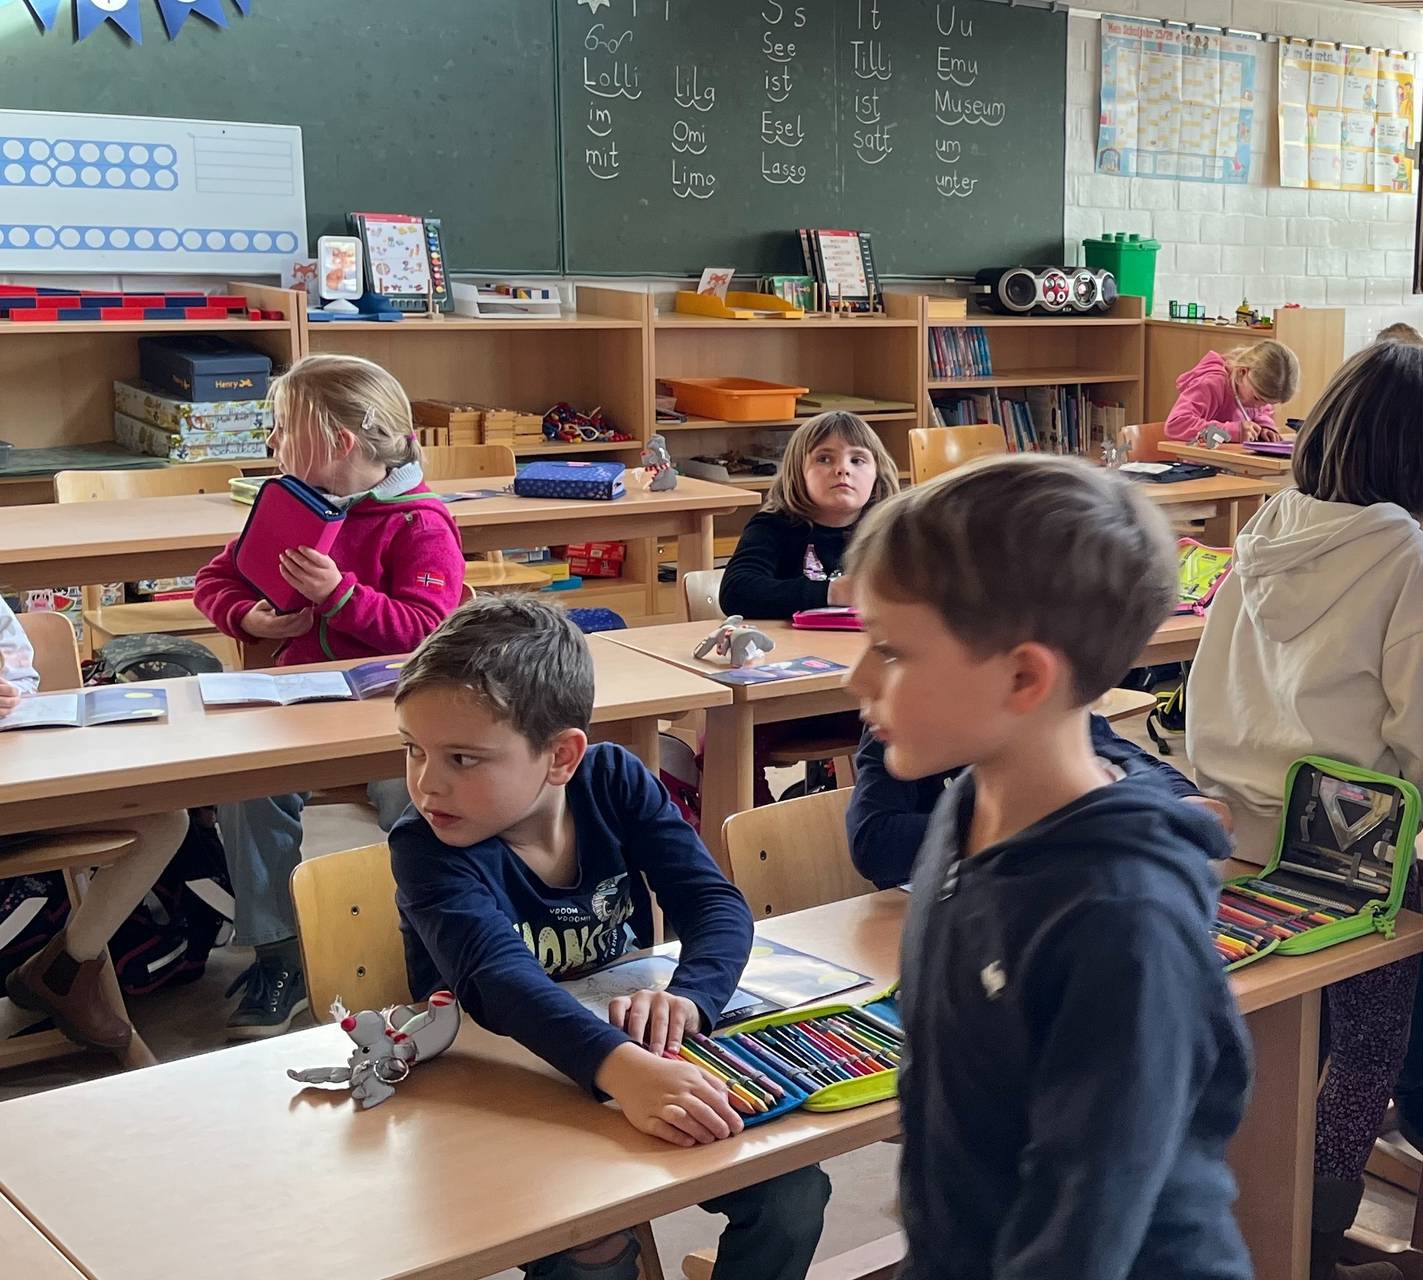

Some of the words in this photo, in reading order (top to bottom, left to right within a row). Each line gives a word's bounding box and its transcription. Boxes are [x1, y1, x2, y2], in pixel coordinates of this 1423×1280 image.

[762, 31, 796, 57] See
[850, 40, 891, 72] Tilli
[584, 57, 638, 88] Lolli
[938, 46, 979, 76] Emu
[765, 65, 793, 92] ist
[590, 101, 611, 125] im
[855, 87, 880, 118] ist
[935, 89, 1006, 117] Museum
[673, 120, 705, 143] Omi
[762, 111, 804, 138] Esel
[586, 141, 619, 168] mit
[762, 151, 807, 178] Lasso
[672, 159, 716, 187] Limo
[935, 170, 979, 190] unter
[215, 380, 239, 389] Henry
